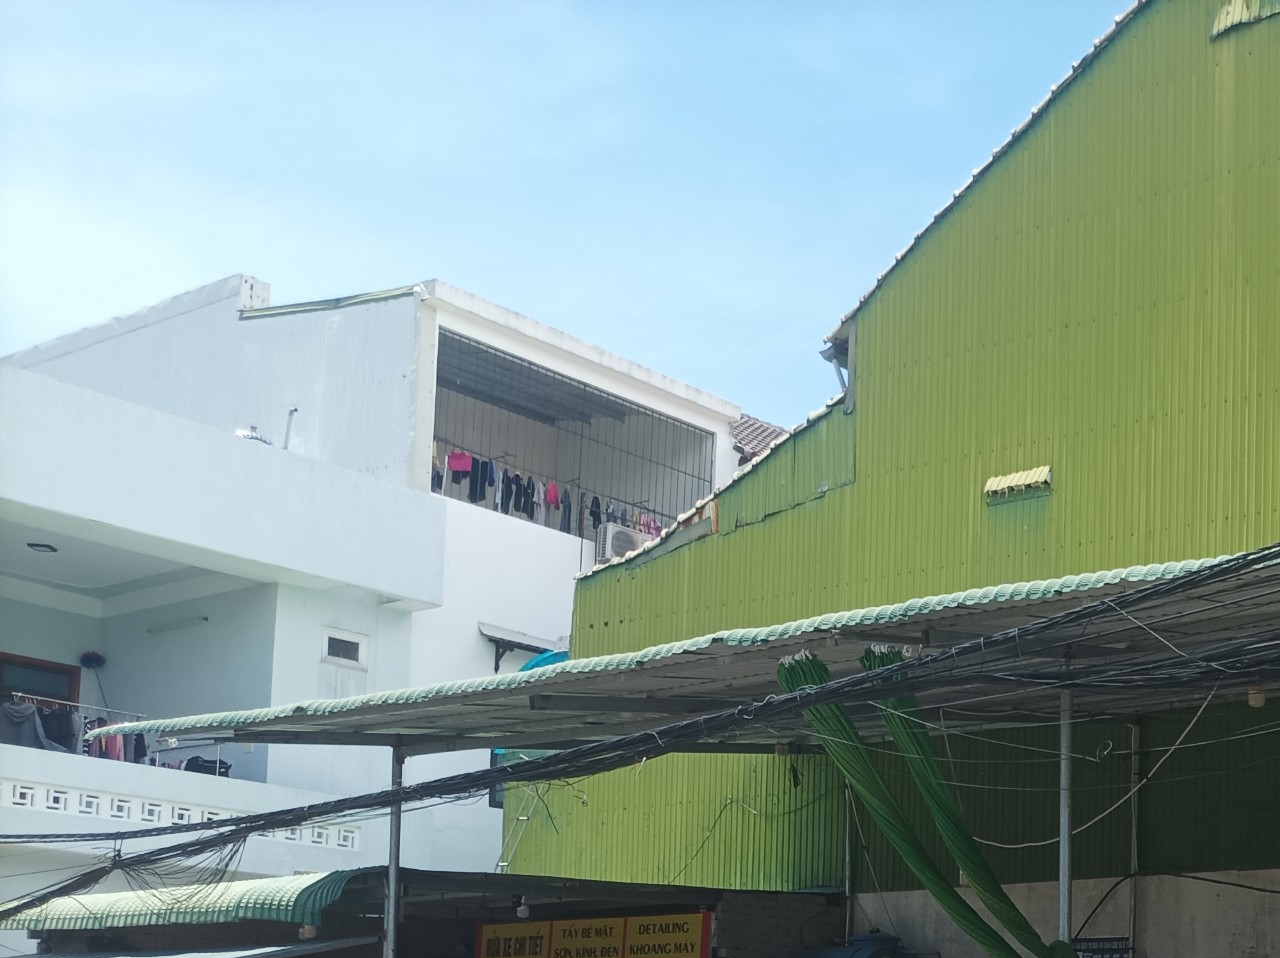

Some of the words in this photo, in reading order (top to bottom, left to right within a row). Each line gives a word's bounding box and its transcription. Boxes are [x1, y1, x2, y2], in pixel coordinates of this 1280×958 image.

[562, 923, 579, 939] TẨY
[594, 923, 614, 941] MẶT
[638, 921, 690, 935] DETAILING
[503, 937, 513, 957] XE
[514, 935, 527, 957] CHI
[528, 928, 544, 956] TIẾT
[600, 943, 619, 958] ĐÈN
[629, 943, 672, 956] KHOANG
[674, 938, 697, 954] MÁY
